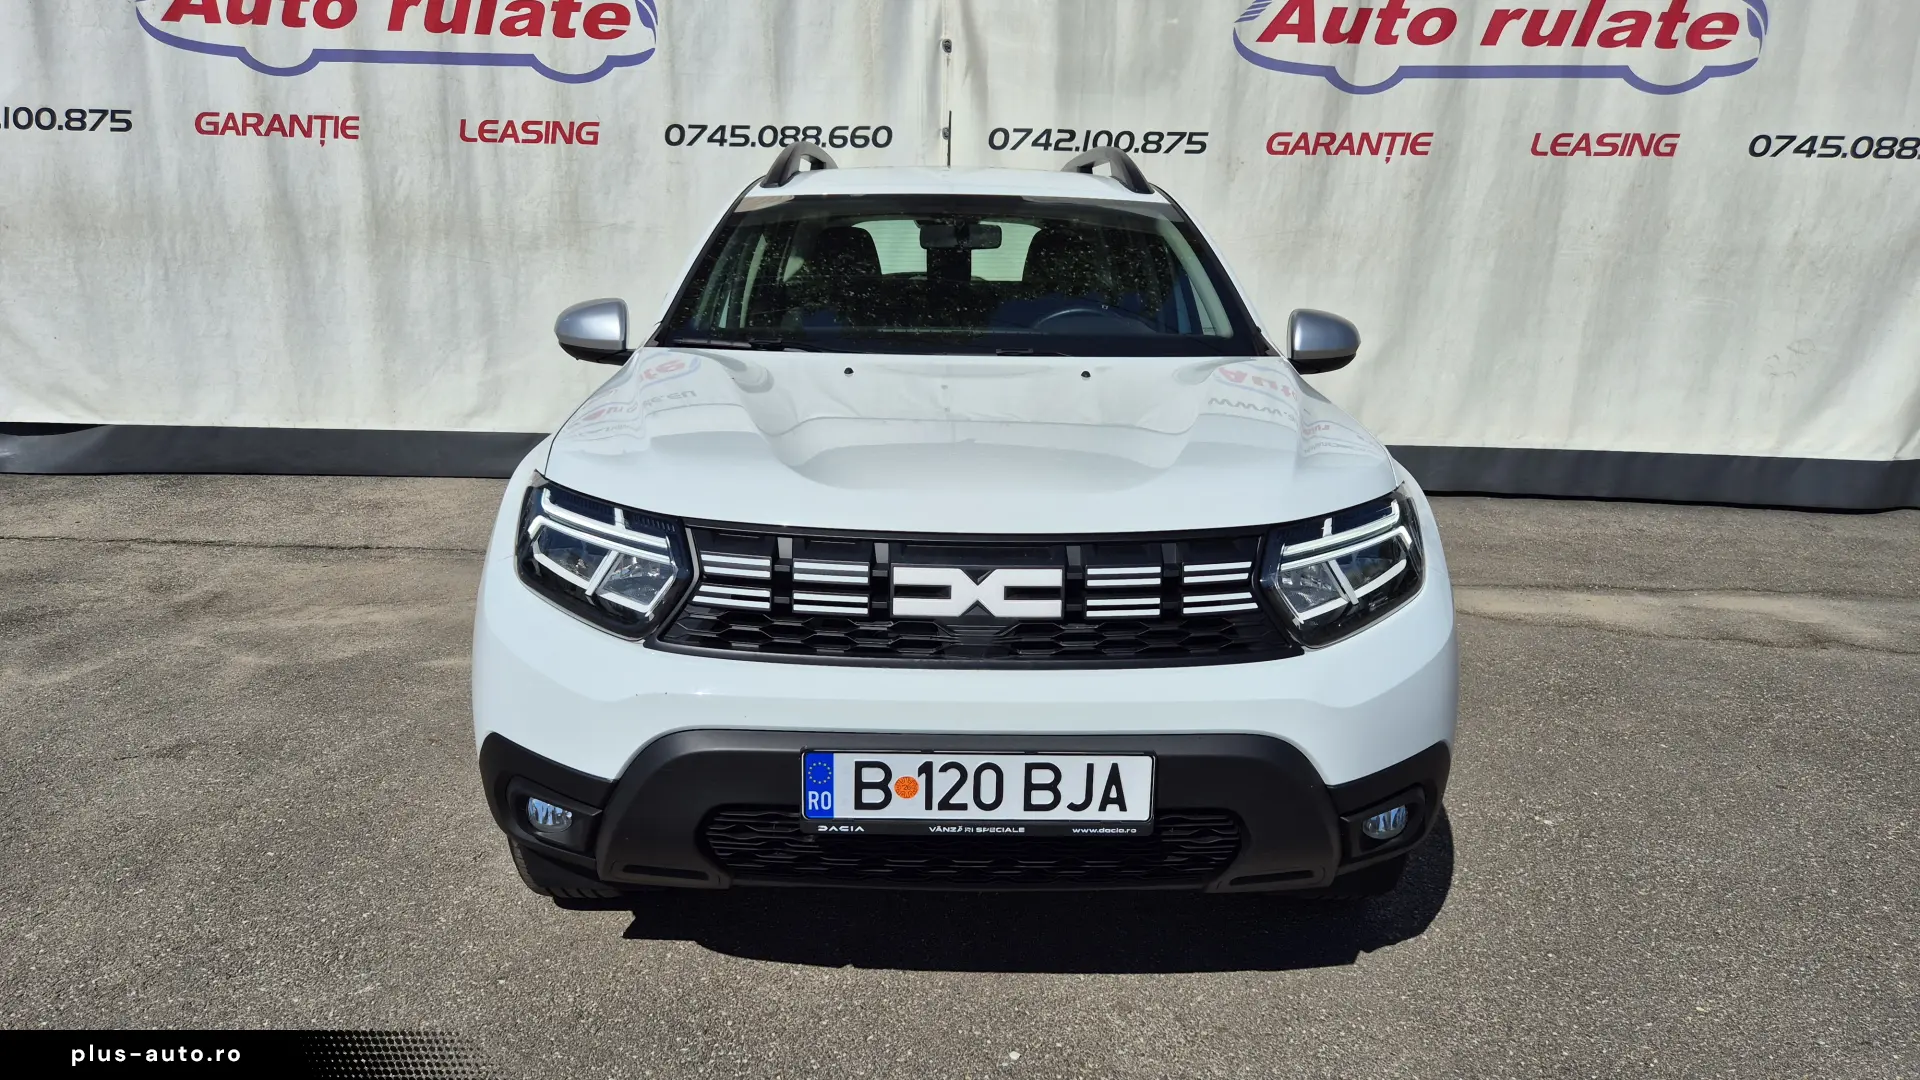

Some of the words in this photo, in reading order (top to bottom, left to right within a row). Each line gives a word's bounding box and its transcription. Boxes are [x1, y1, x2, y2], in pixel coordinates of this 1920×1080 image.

[387, 0, 632, 41] rulate
[1256, 0, 1458, 47] Auto
[1480, 0, 1741, 51] rulate
[0, 106, 132, 132] 100.875
[460, 119, 600, 145] LEASING
[664, 123, 893, 149] 0745.088.660
[988, 127, 1209, 154] 0742.100.875
[1530, 132, 1680, 158] LEASING
[854, 760, 893, 811] B
[917, 760, 1004, 812] 120
[1023, 762, 1128, 812] BJA
[808, 790, 832, 810] RO
